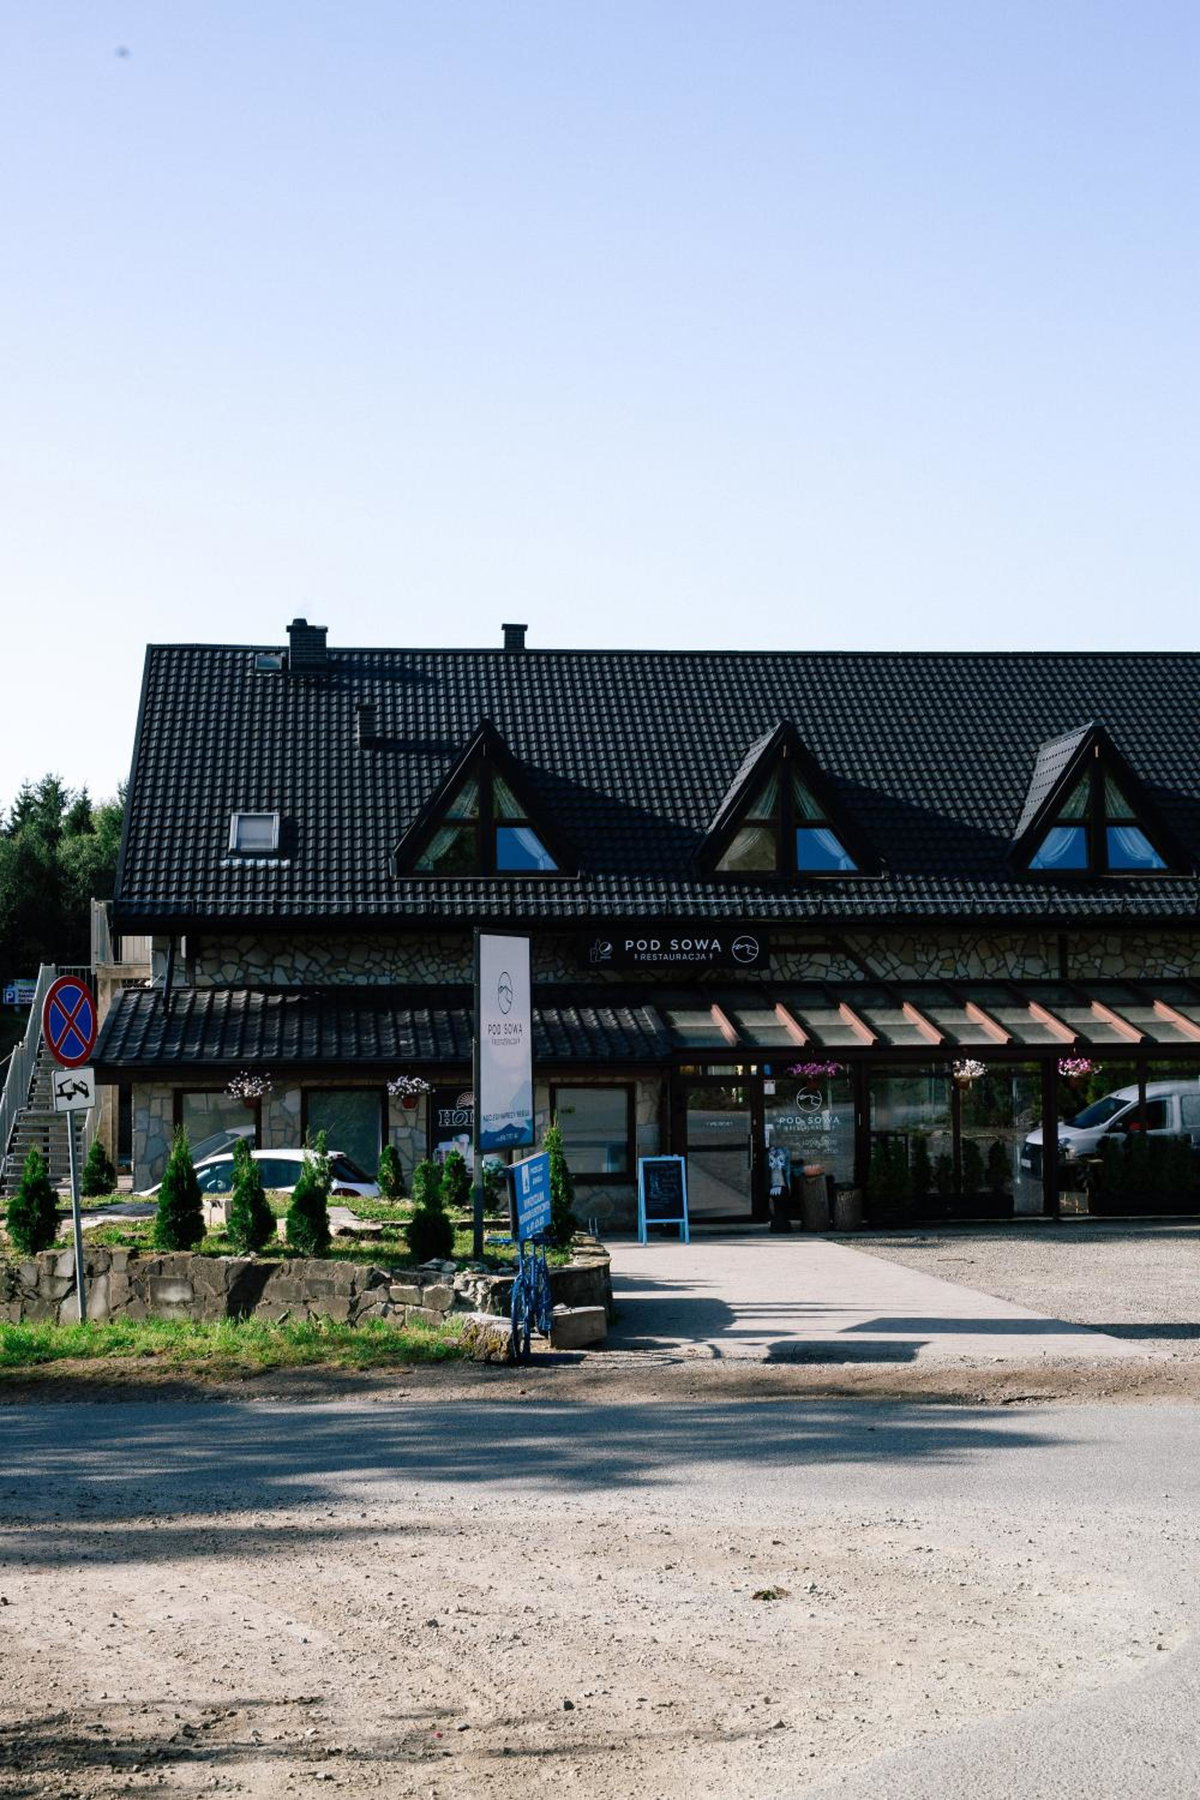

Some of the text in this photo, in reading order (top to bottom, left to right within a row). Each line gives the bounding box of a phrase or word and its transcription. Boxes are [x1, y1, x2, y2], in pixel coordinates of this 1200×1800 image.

[625, 940, 661, 951] POD
[640, 953, 707, 961] RESTAURACJA
[439, 1109, 475, 1127] HOL
